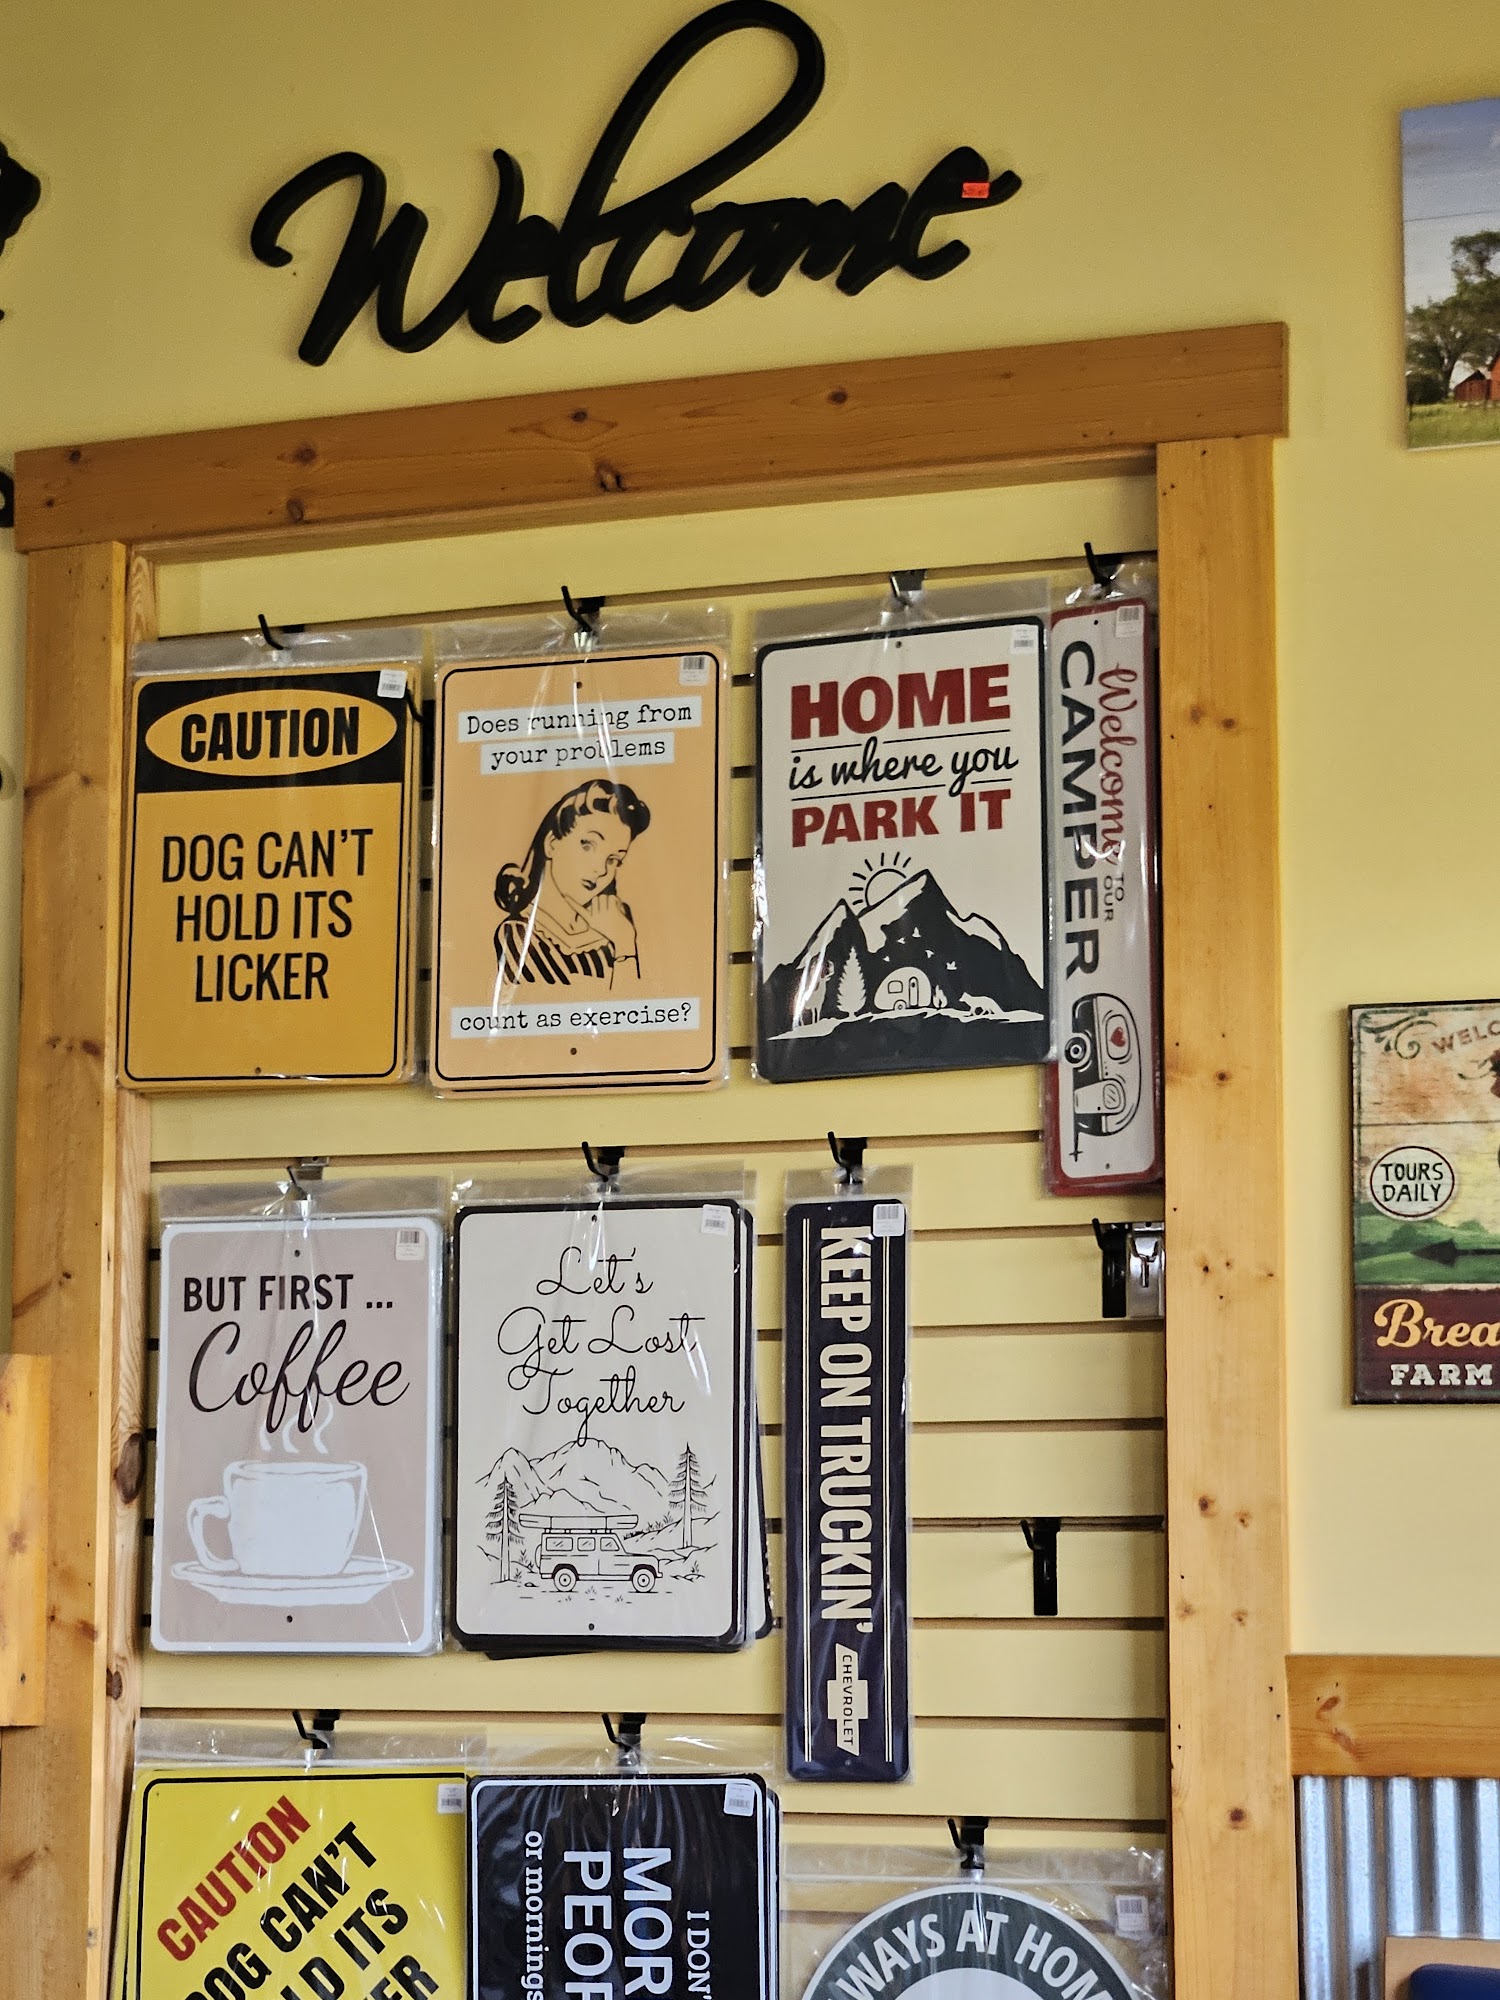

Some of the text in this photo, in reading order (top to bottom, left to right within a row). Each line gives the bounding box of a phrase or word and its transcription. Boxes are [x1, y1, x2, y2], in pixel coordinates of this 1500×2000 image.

[251, 0, 1022, 367] Welcome
[466, 703, 692, 736] Does running from
[790, 664, 1010, 740] HOME
[180, 706, 360, 763] CAUTION
[490, 740, 666, 770] your problems
[789, 737, 1019, 797] is where you
[1098, 662, 1138, 865] Welcome
[792, 789, 1011, 848] PARK IT
[1060, 641, 1100, 979] CAMPER
[162, 828, 373, 883] DOG CAN'T
[1103, 875, 1114, 923] OUR
[1114, 872, 1125, 902] TO
[176, 890, 352, 942] HOLD ITS
[195, 952, 329, 1003] LICKER
[459, 1002, 692, 1032] count as exercise?
[1381, 1162, 1444, 1182] TOURS
[1382, 1183, 1442, 1203] DAILY
[183, 1276, 247, 1313] BUT
[259, 1274, 354, 1311] FIRST
[536, 1246, 654, 1296] Let's
[497, 1305, 705, 1378] Get Lost
[188, 1319, 410, 1434] Coffee
[1390, 1364, 1493, 1386] FARM
[508, 1365, 685, 1447] Together
[819, 1226, 875, 1634] KEEP ON TRUCKIN'
[842, 1654, 853, 1746] CHEVROLET
[525, 1830, 543, 1860] or
[157, 1795, 311, 1962] CAUTION
[181, 1942, 272, 2000] OG
[260, 1821, 377, 1953] CAN'T
[333, 1888, 409, 1971] ITS
[687, 1911, 710, 1921] I
[828, 1913, 946, 2000] WAYS
[956, 1909, 1009, 1955] AT
